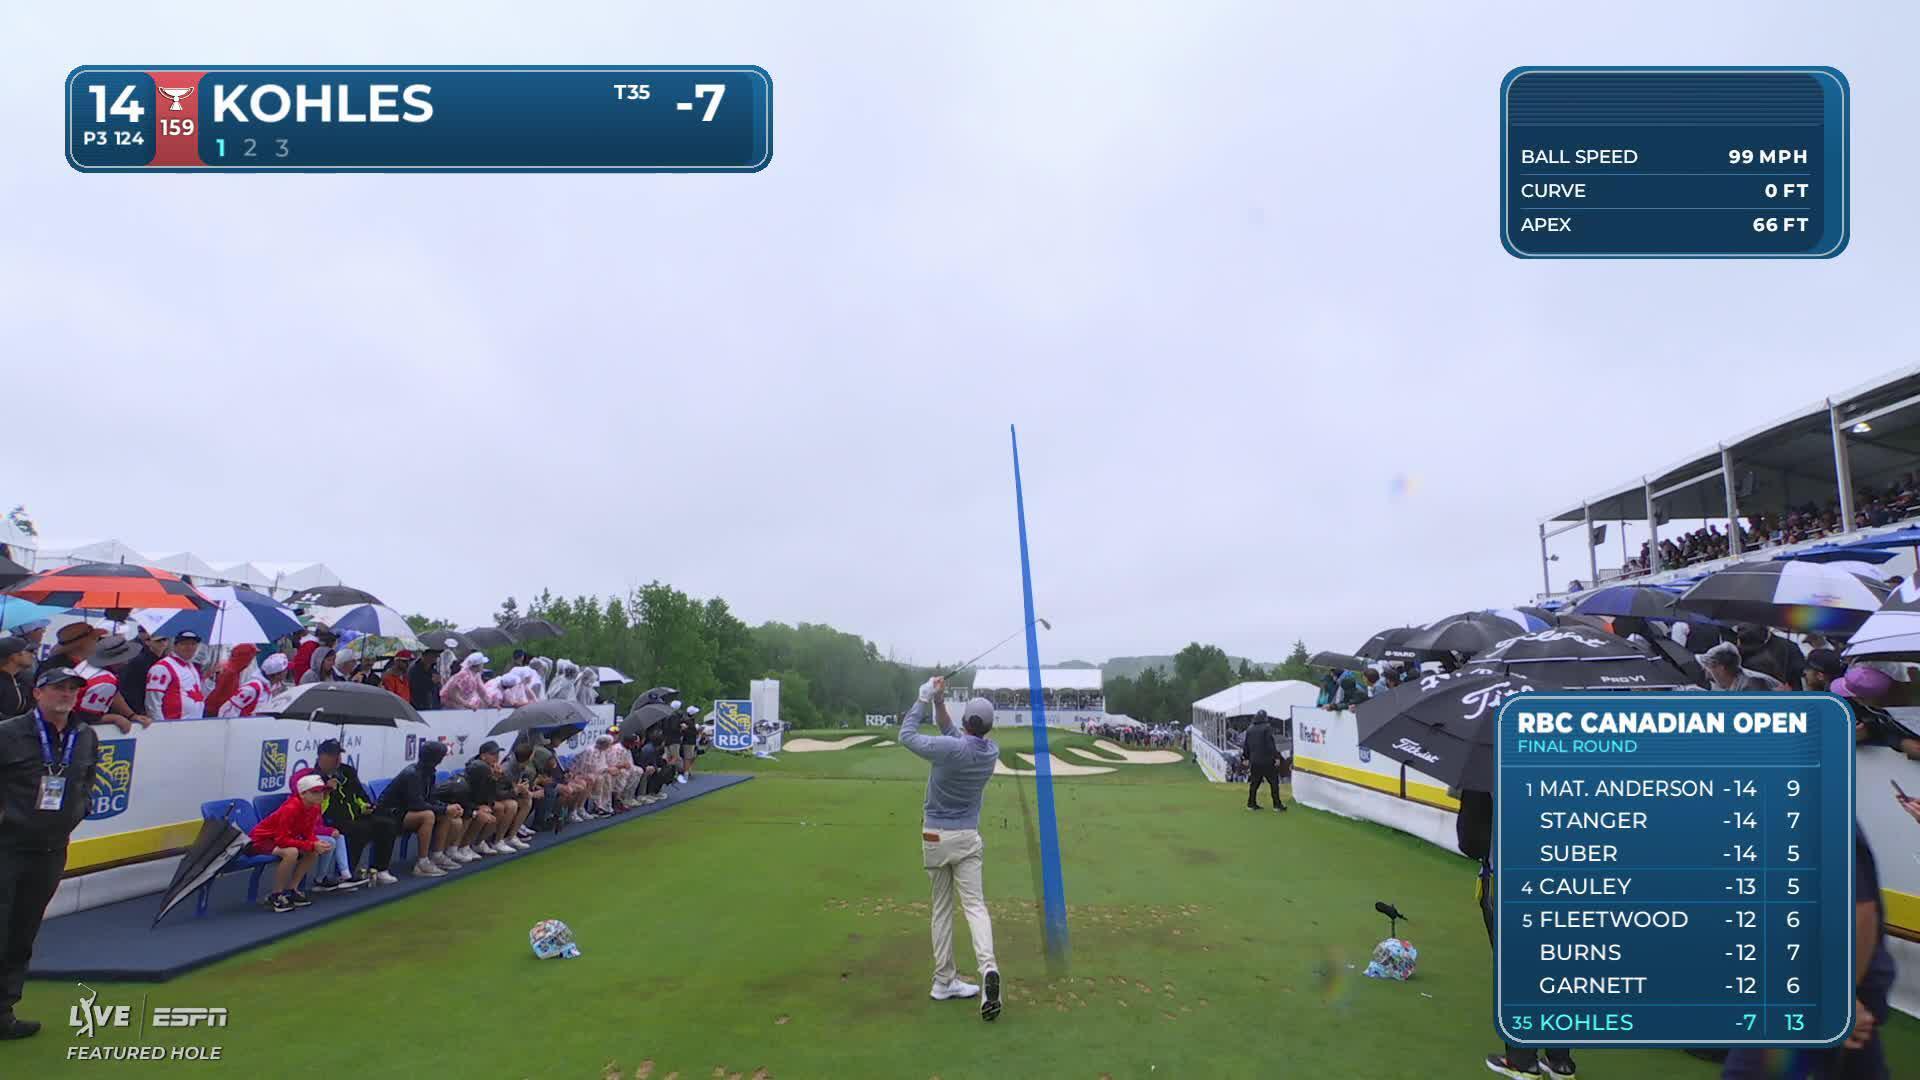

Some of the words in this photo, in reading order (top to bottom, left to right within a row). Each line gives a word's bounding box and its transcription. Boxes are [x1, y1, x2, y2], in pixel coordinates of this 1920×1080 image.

[866, 714, 893, 727] RBC
[718, 734, 750, 746] RBC
[261, 775, 284, 789] RBC
